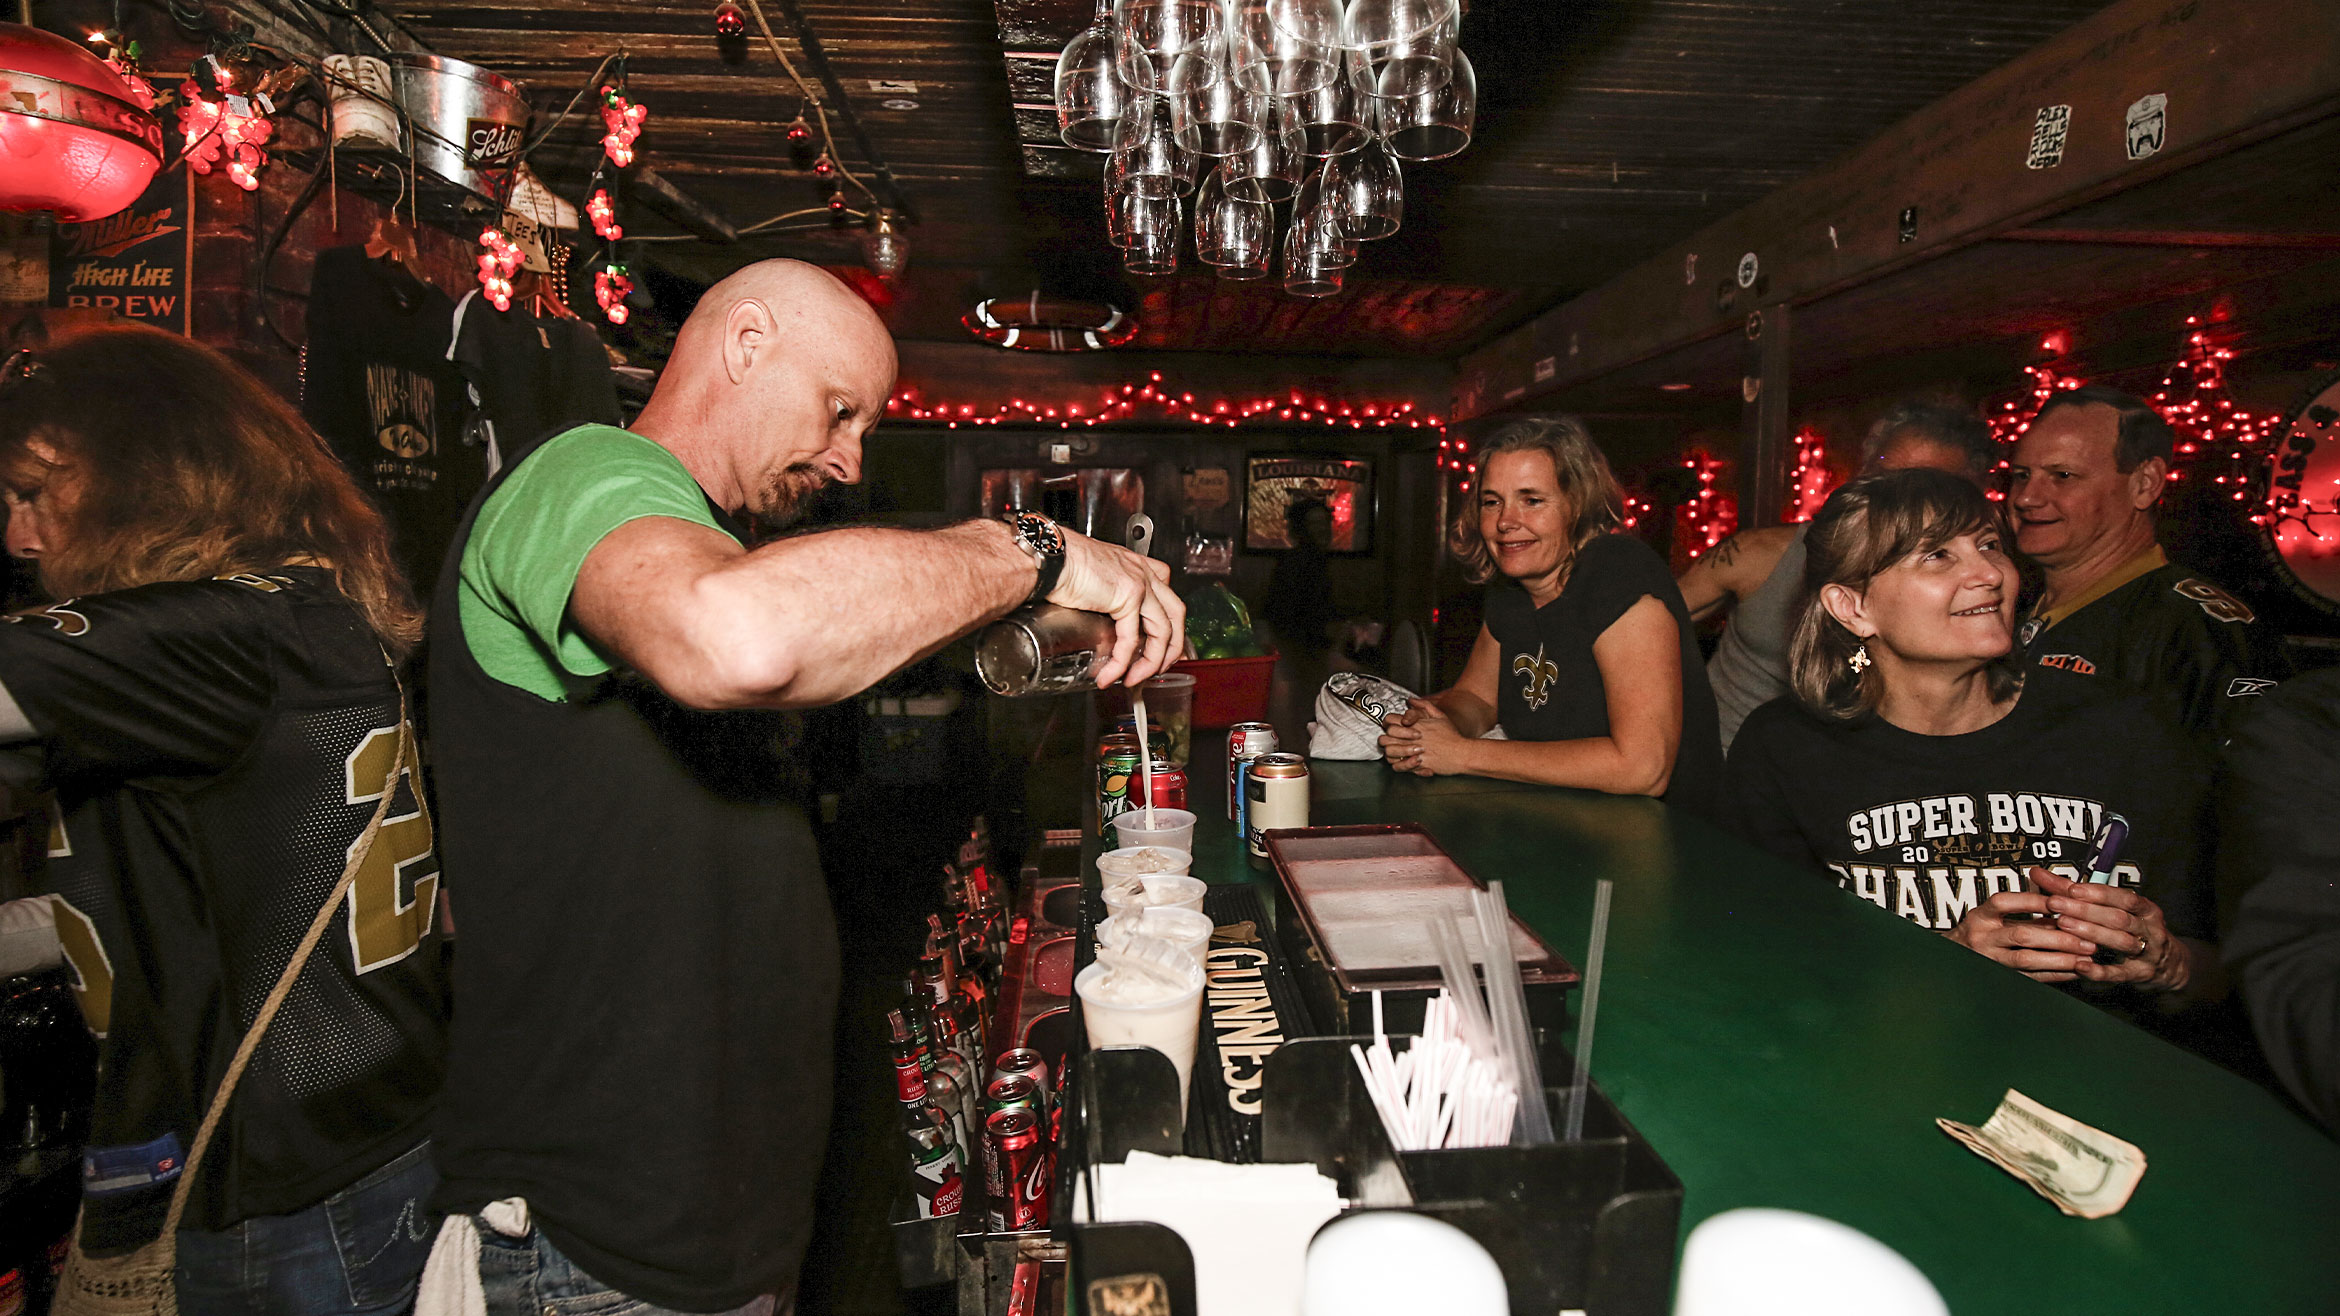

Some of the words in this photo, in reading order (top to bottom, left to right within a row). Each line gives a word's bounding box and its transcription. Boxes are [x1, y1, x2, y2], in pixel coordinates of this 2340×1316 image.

[2037, 106, 2068, 122] ALEX
[472, 127, 522, 159] Schlit
[58, 207, 172, 257] Miller
[503, 210, 538, 246] TEES
[68, 296, 176, 317] BREW
[1257, 462, 1363, 479] LOUISIANA
[1849, 794, 1978, 852] SUPER
[1987, 793, 2112, 850] BOWL
[1902, 845, 1929, 863] 20
[2032, 840, 2062, 859] 09
[907, 1099, 920, 1110] ONE
[939, 1195, 963, 1215] RUSS
